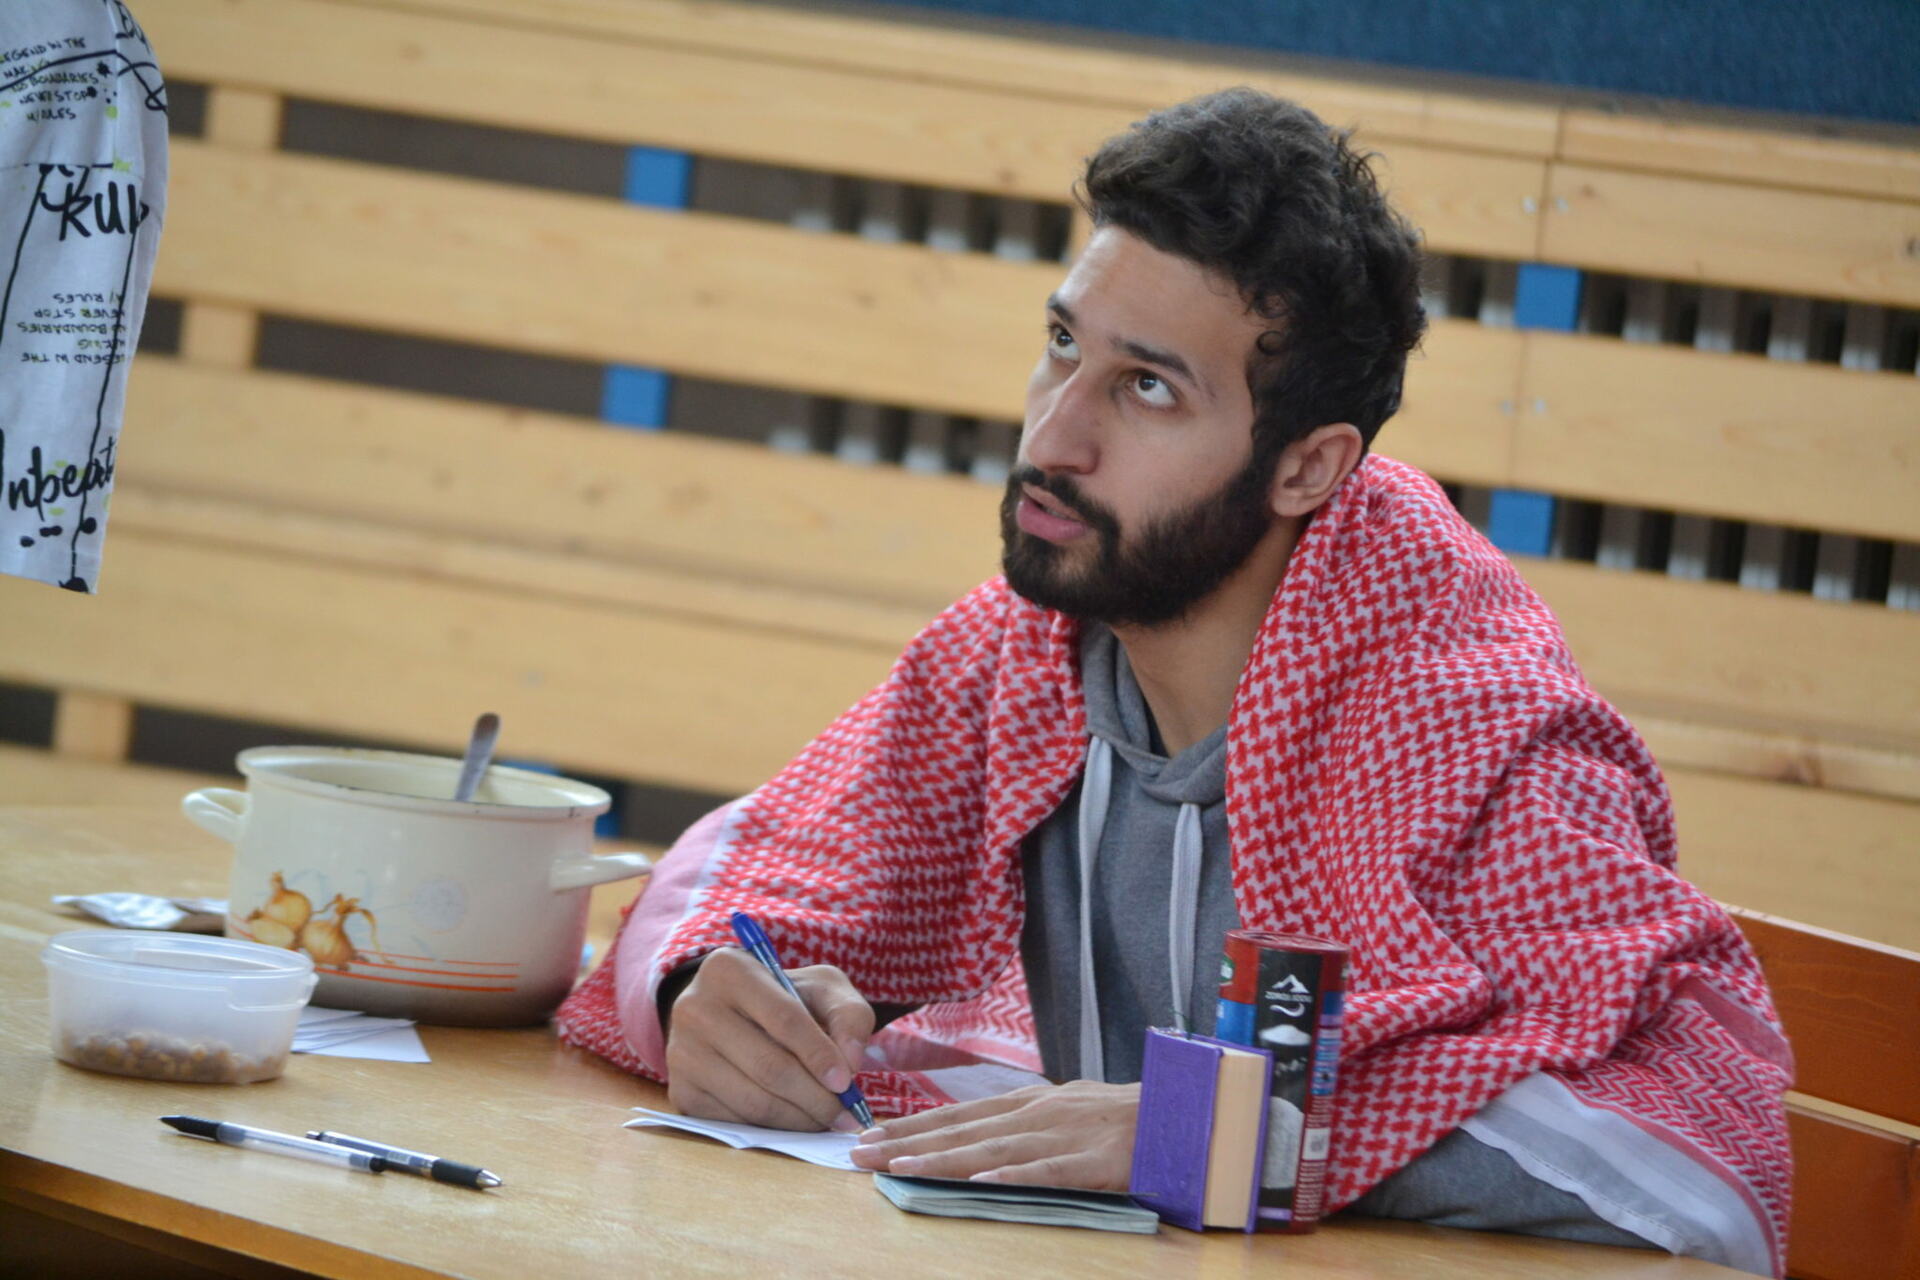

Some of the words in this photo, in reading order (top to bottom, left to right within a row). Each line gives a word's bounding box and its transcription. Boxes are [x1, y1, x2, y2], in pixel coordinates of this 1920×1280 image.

[52, 292, 104, 304] RULES
[34, 308, 75, 318] STOP
[16, 321, 107, 335] BOUNDARIES
[20, 352, 49, 363] THE
